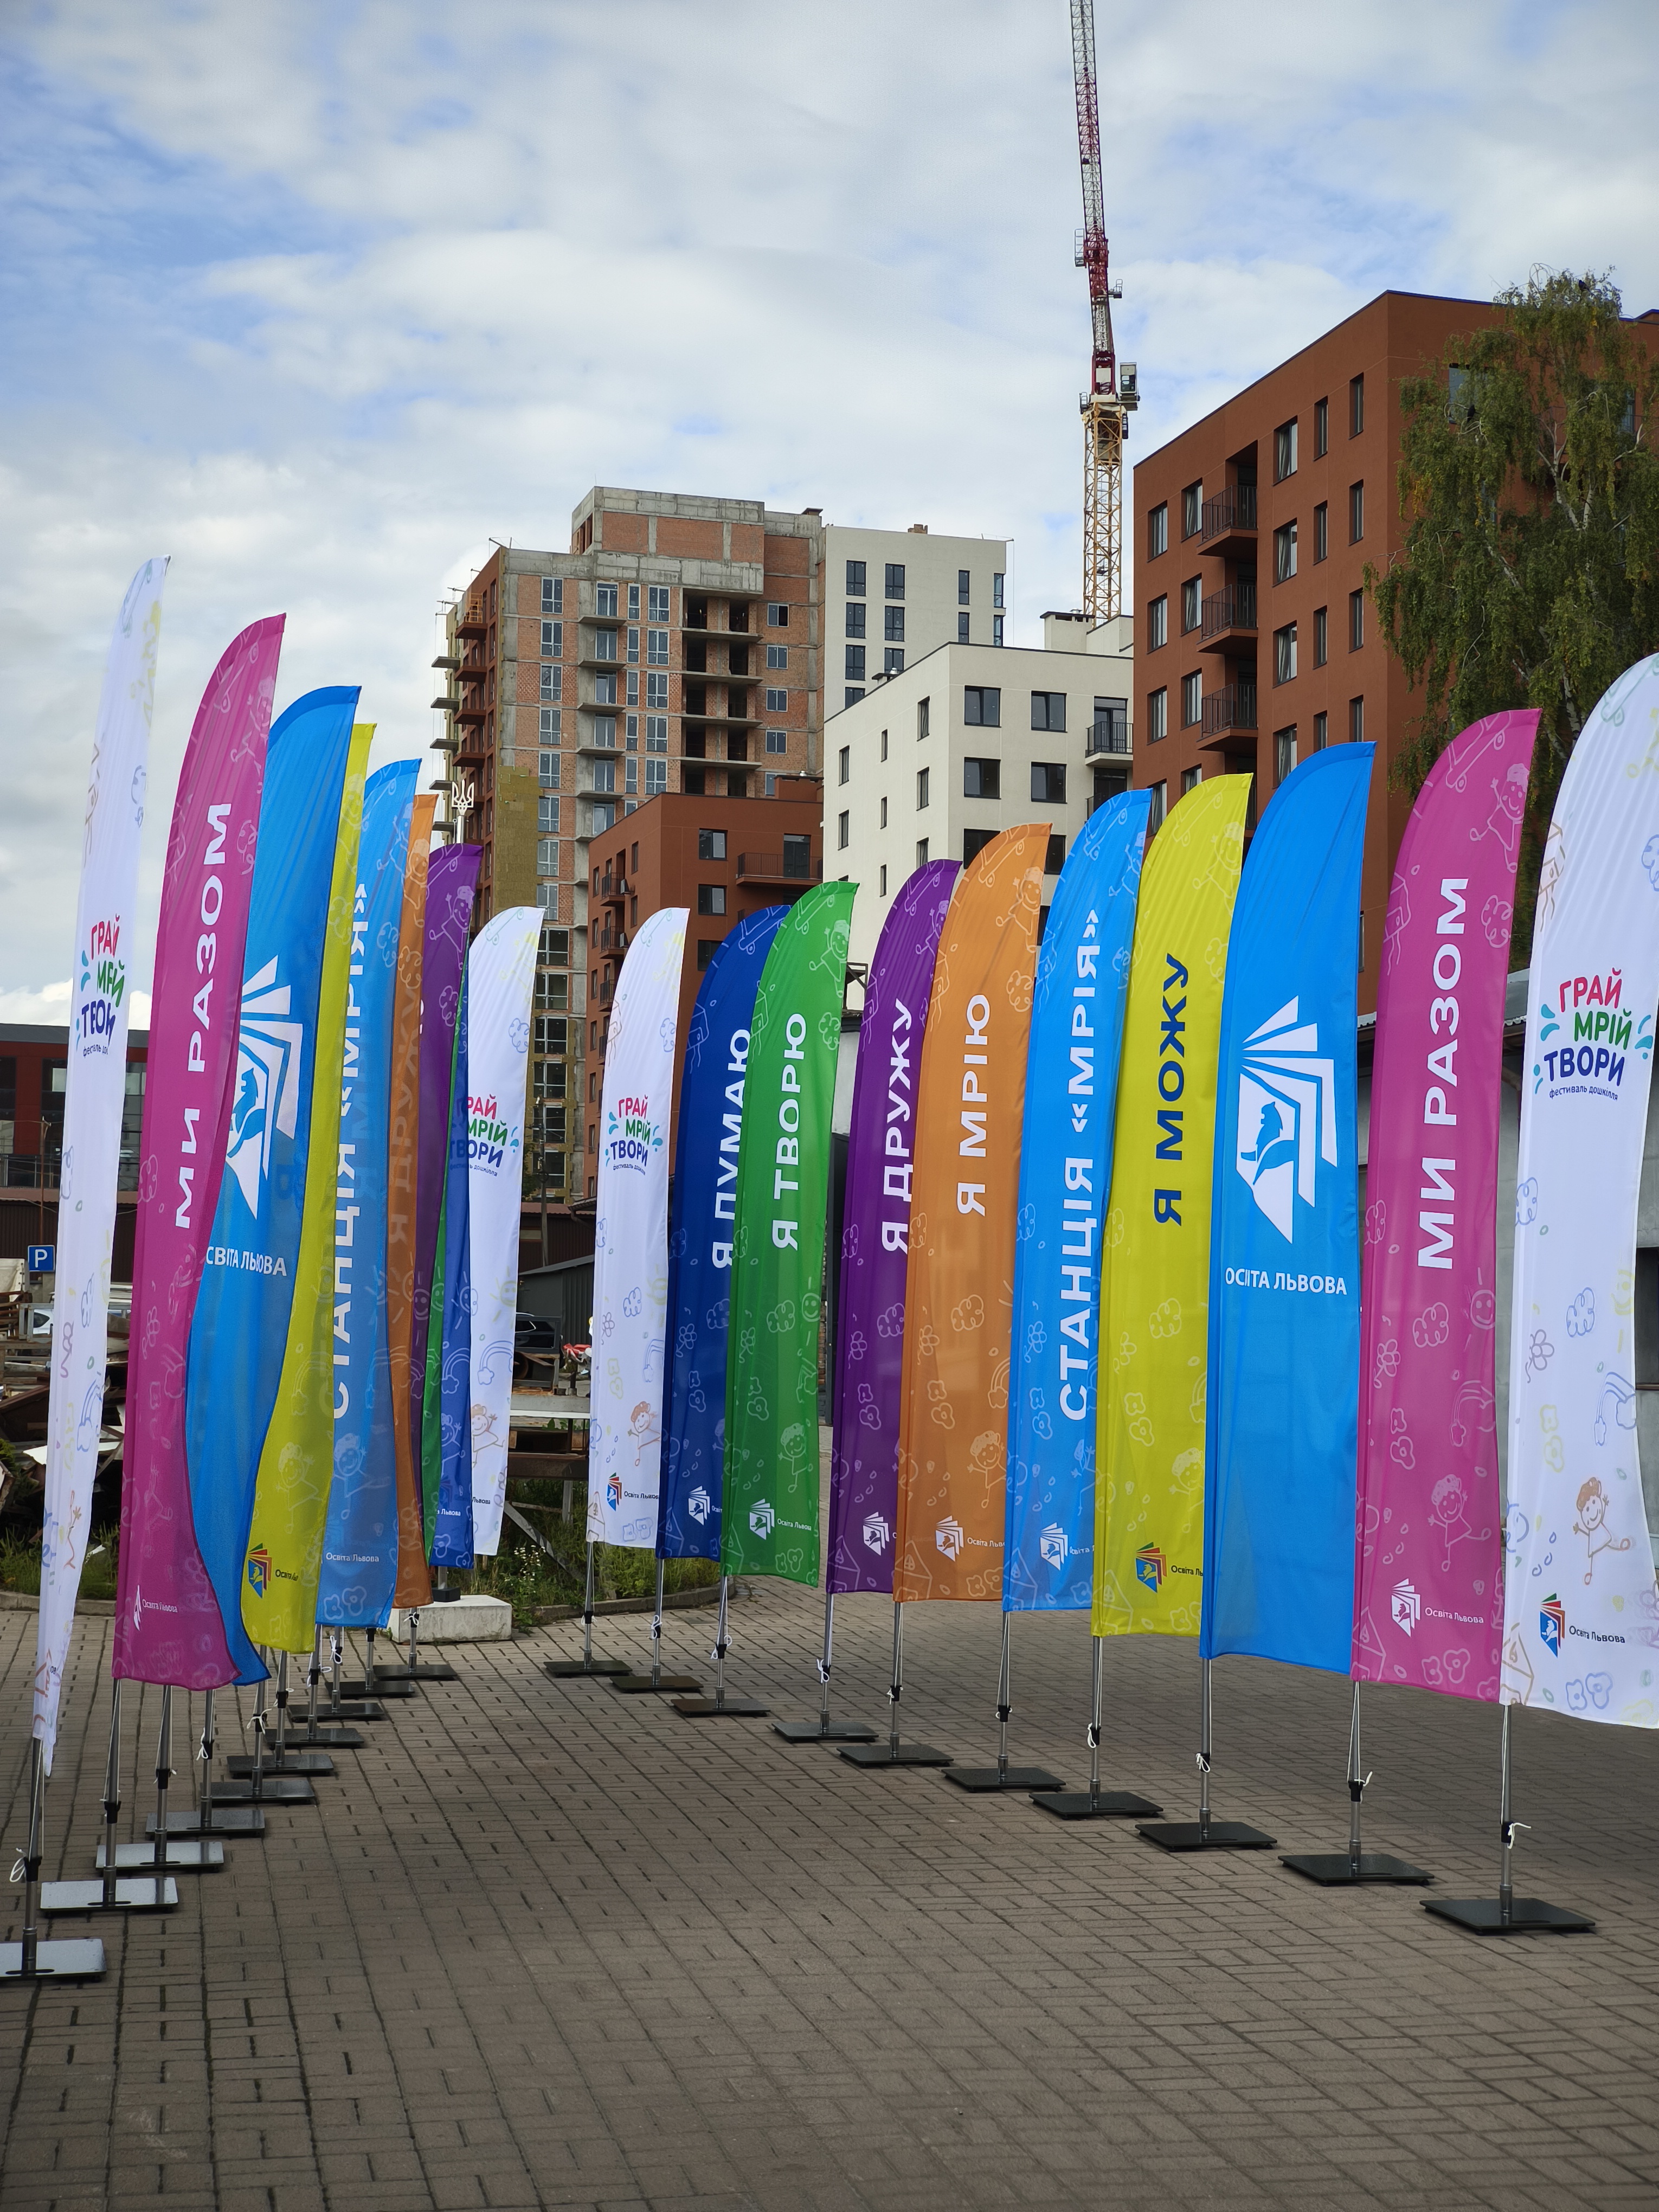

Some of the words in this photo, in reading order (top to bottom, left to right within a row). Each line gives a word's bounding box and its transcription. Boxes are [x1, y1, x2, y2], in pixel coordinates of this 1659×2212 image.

[91, 913, 120, 960] ГРАЙ
[1424, 877, 1469, 1127] РАЗОМ
[1559, 967, 1622, 1013] ГРАЙ
[175, 1108, 200, 1229] МИ
[188, 803, 232, 1073] РАЗОМ
[1068, 909, 1099, 1133] «МРІЯ»
[1573, 1008, 1632, 1050] МРІЙ
[1155, 953, 1189, 1161] МОЖУ
[1544, 1045, 1625, 1087] ТВОРИ
[959, 994, 991, 1158] МРІЮ
[618, 1094, 648, 1120] ГРАЙ
[774, 1013, 807, 1200] ТВОРЮ
[883, 998, 914, 1203] ДРУЖУ
[1549, 1085, 1587, 1099] фестиваль
[1589, 1085, 1618, 1101] дошкілля
[466, 1118, 508, 1146] МРІЙ
[626, 1118, 651, 1146] МРІЙ
[610, 1140, 648, 1167] ТВОРИ
[957, 1182, 986, 1217] Я
[1154, 1188, 1182, 1227] Я
[1417, 1157, 1457, 1270] МИ
[771, 1220, 799, 1251] Я
[882, 1221, 908, 1255] Я
[35, 1249, 48, 1268] P
[206, 1246, 239, 1269] СВІТА
[712, 1242, 734, 1268] Я
[1059, 1157, 1097, 1421] СТАНЦІЯ
[1225, 1266, 1270, 1289] ОСІТА
[1273, 1271, 1347, 1295] ЛЬВОВА
[623, 1490, 640, 1499] Освіта
[711, 1505, 723, 1513] Освіт
[777, 1518, 794, 1527] Освіта
[794, 1521, 812, 1531] Львова
[325, 1552, 351, 1561] Освіта
[352, 1554, 380, 1562] Львова
[967, 1537, 988, 1547] Освіта
[1171, 1565, 1194, 1575] Освіта
[1425, 1606, 1453, 1620] Освіта
[1454, 1612, 1484, 1624] Львова
[1591, 1631, 1625, 1643] Львова
